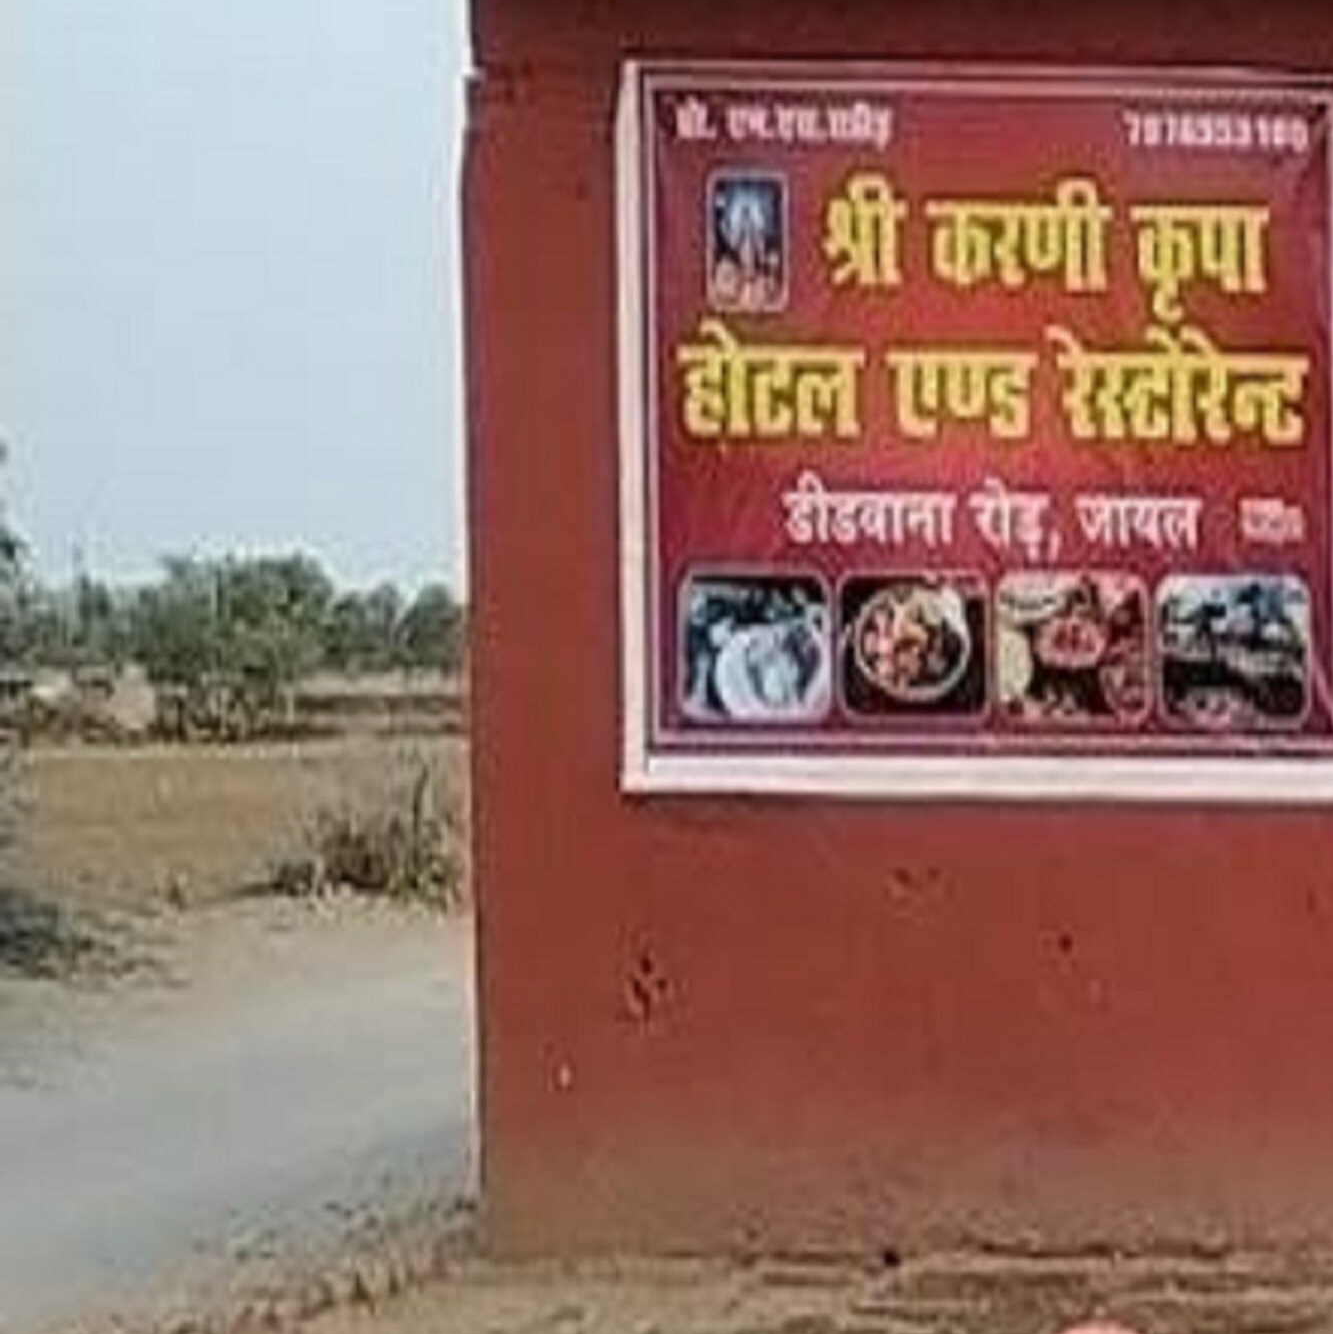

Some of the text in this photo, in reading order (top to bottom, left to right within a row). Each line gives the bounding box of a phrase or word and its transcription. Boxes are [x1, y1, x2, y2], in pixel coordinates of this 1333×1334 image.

[824, 173, 1270, 322] श्री करणी कृपा
[676, 321, 866, 439] होटल
[886, 351, 1038, 439] एण्ड
[783, 471, 957, 547] डीडवाना
[1075, 495, 1203, 548] जायल
